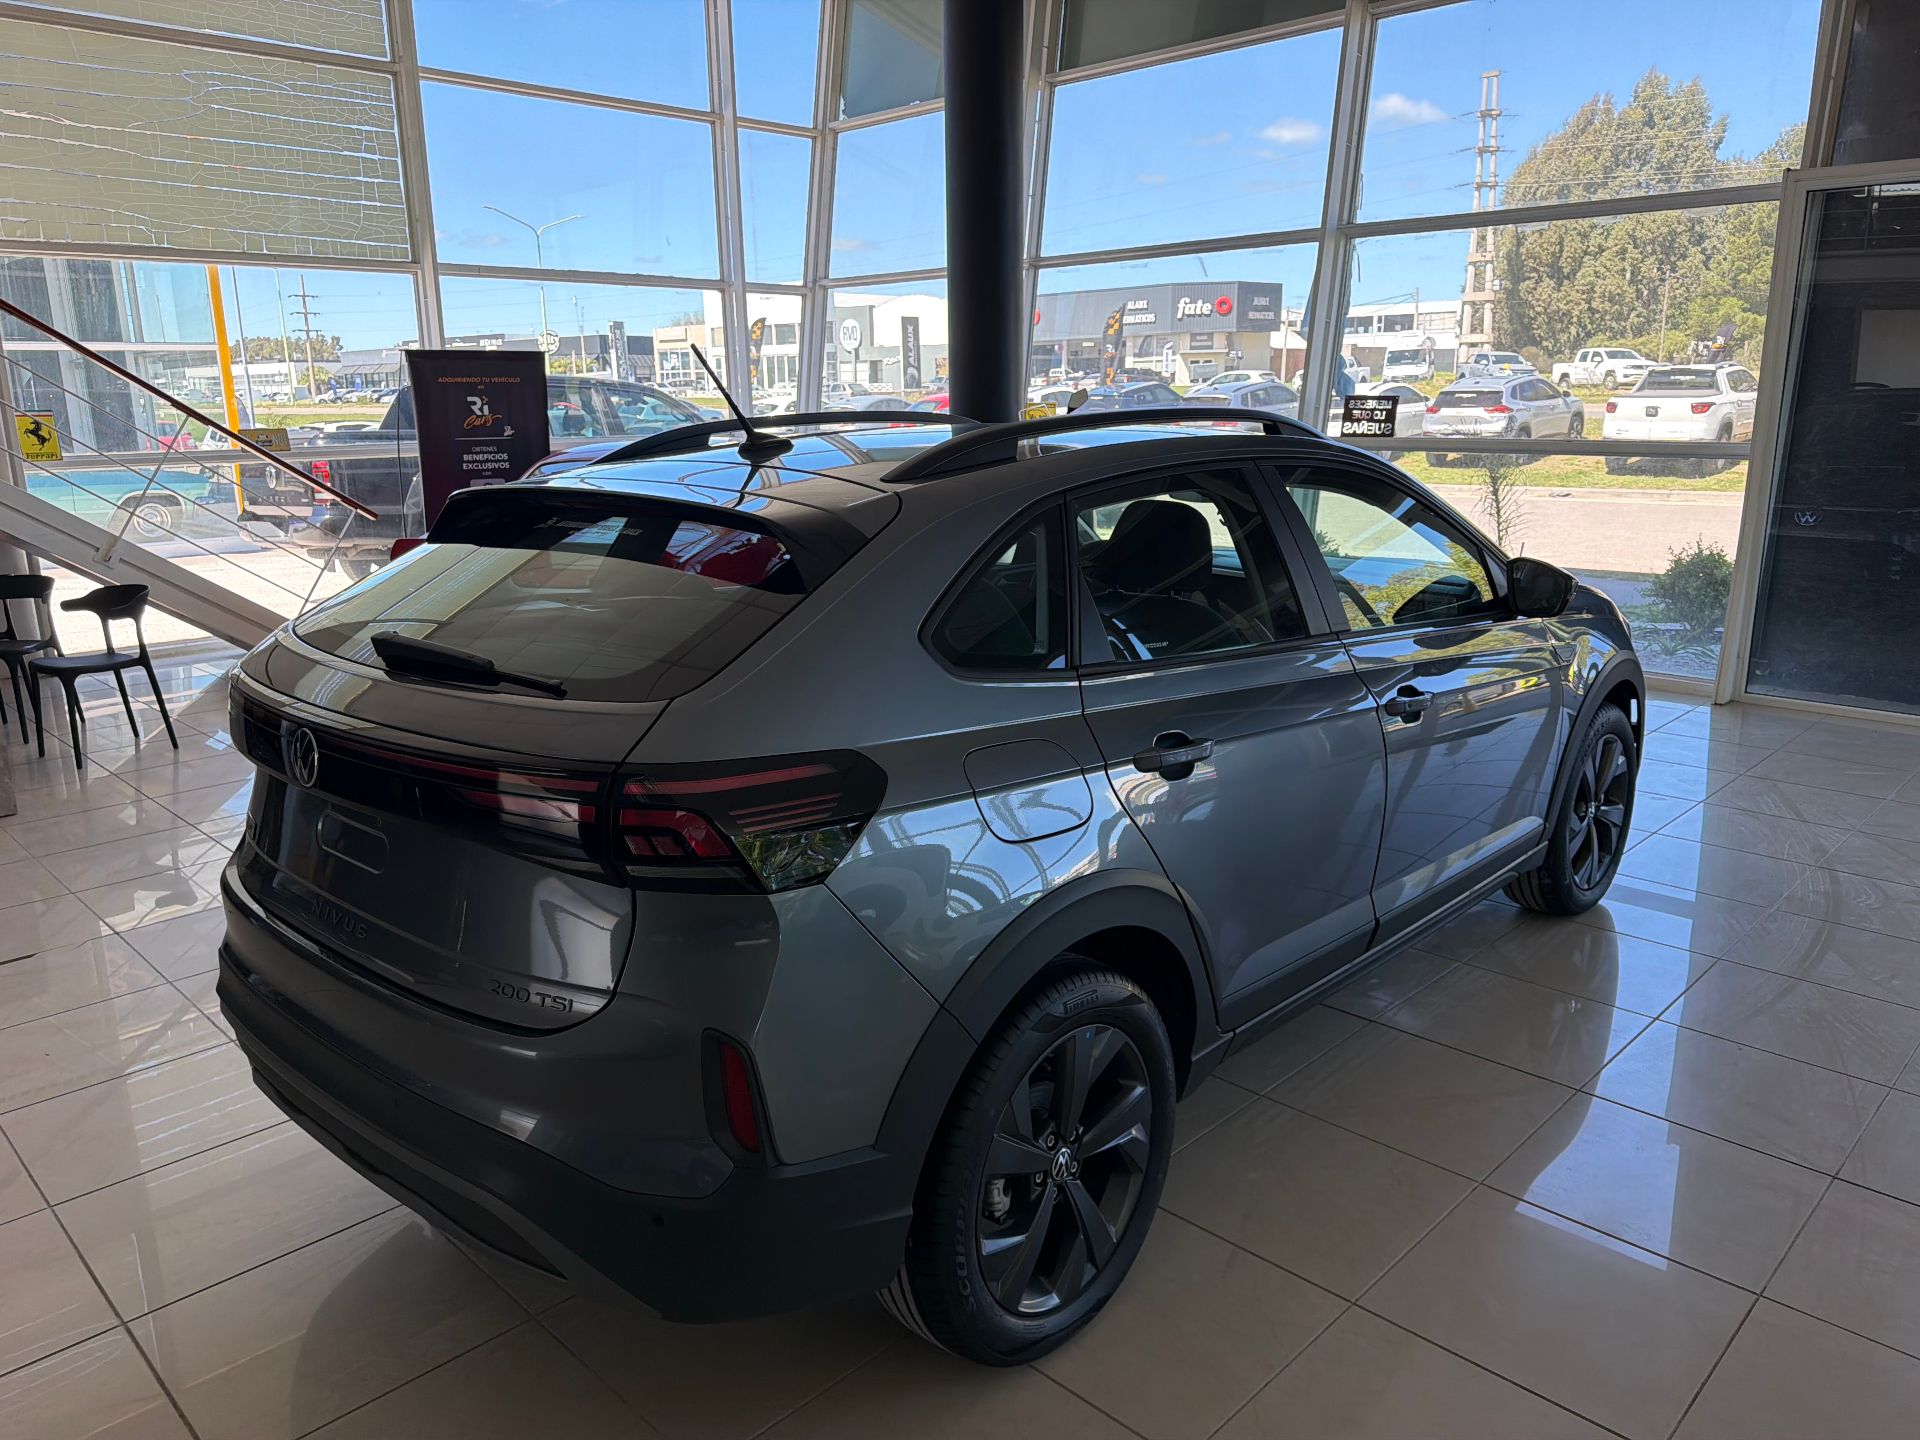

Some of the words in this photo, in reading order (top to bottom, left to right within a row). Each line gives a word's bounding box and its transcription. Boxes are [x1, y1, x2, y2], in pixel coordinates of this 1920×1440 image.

[1177, 297, 1212, 319] fate
[26, 452, 58, 460] Ferrari
[462, 462, 510, 470] EXCLUSIVOS
[463, 453, 509, 461] BENEFICIOS
[312, 898, 367, 938] NIVUS
[488, 979, 531, 1003] 200
[535, 991, 574, 1014] TSI
[1062, 988, 1099, 1016] PIRELLI
